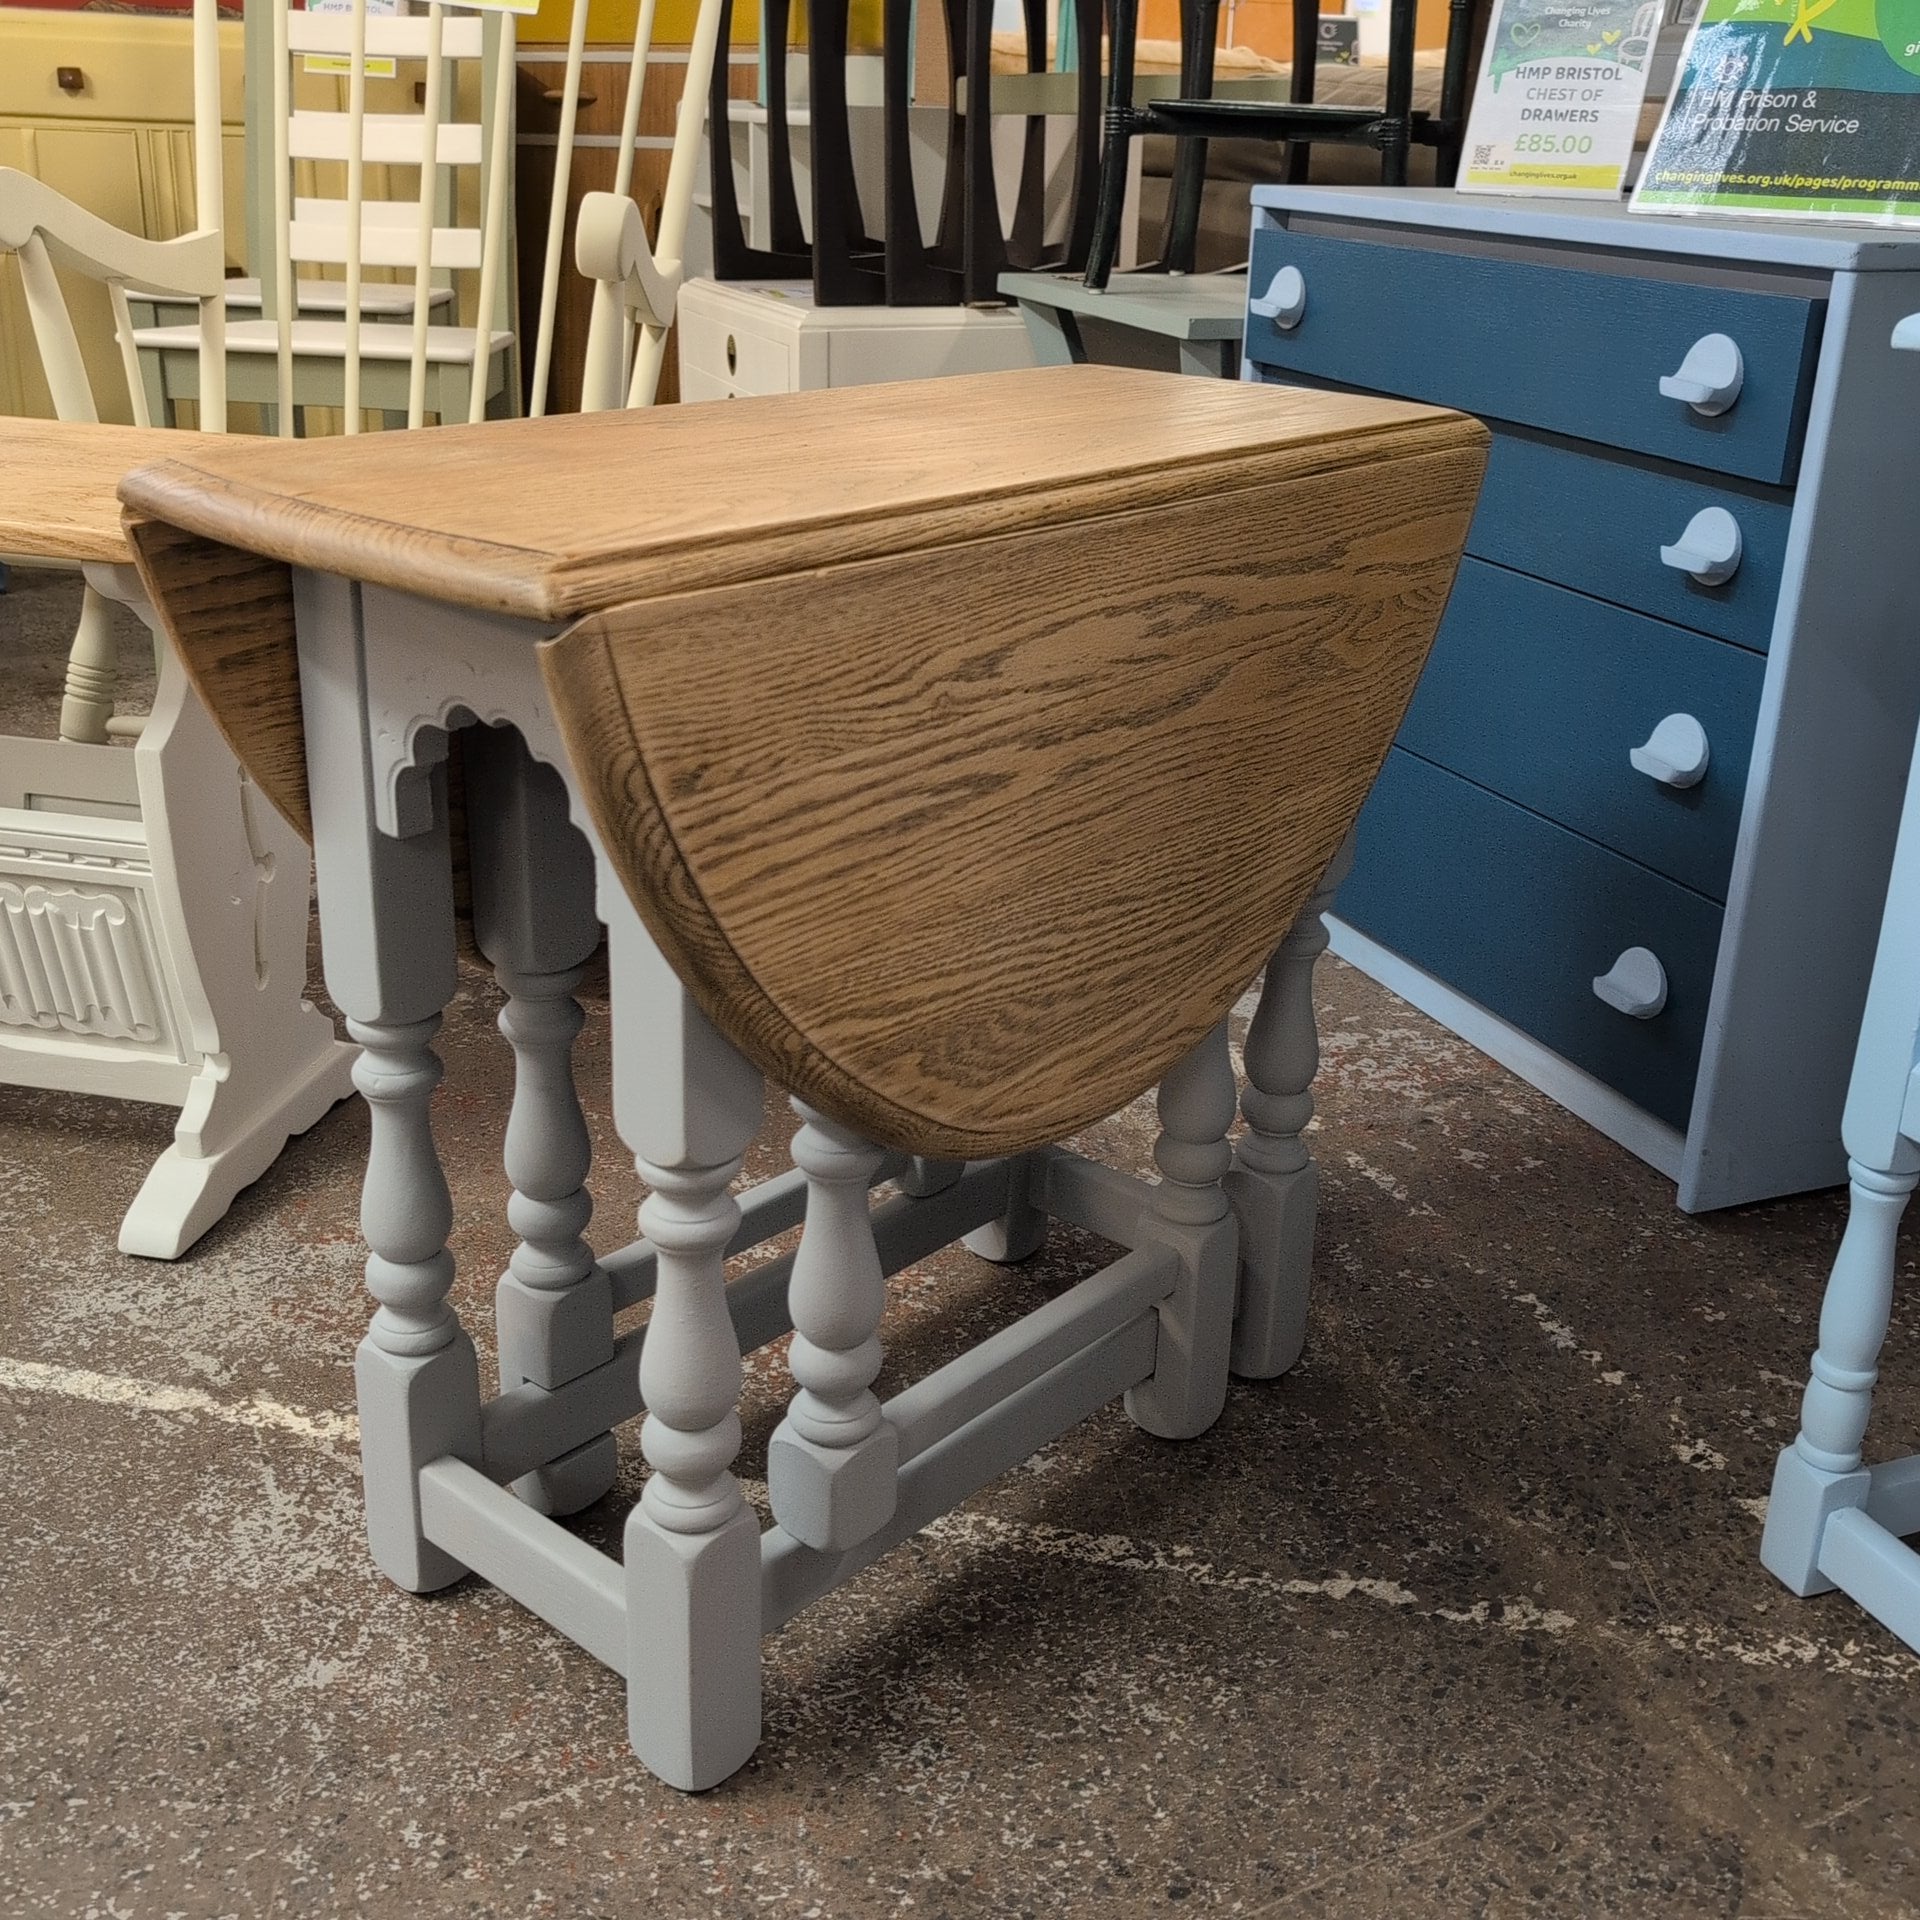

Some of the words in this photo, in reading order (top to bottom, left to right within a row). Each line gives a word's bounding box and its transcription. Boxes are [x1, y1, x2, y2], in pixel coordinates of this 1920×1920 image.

[1544, 6, 1587, 17] Changing
[1587, 6, 1611, 16] Lives
[1558, 19, 1592, 31] Charity
[1515, 66, 1552, 80] HMP
[1554, 67, 1623, 81] BRISTOL
[1526, 87, 1578, 101] CHEST
[1580, 88, 1604, 102] OF
[1698, 91, 1735, 107] HM
[1737, 90, 1798, 109] Prison
[1801, 90, 1818, 109] &
[1520, 108, 1600, 123] DRAWERS
[1691, 113, 1779, 132] Probation
[1784, 114, 1860, 134] Service
[1514, 133, 1593, 154] £85.00
[1655, 171, 1920, 192] changinglives.org.uk/pages/programm
